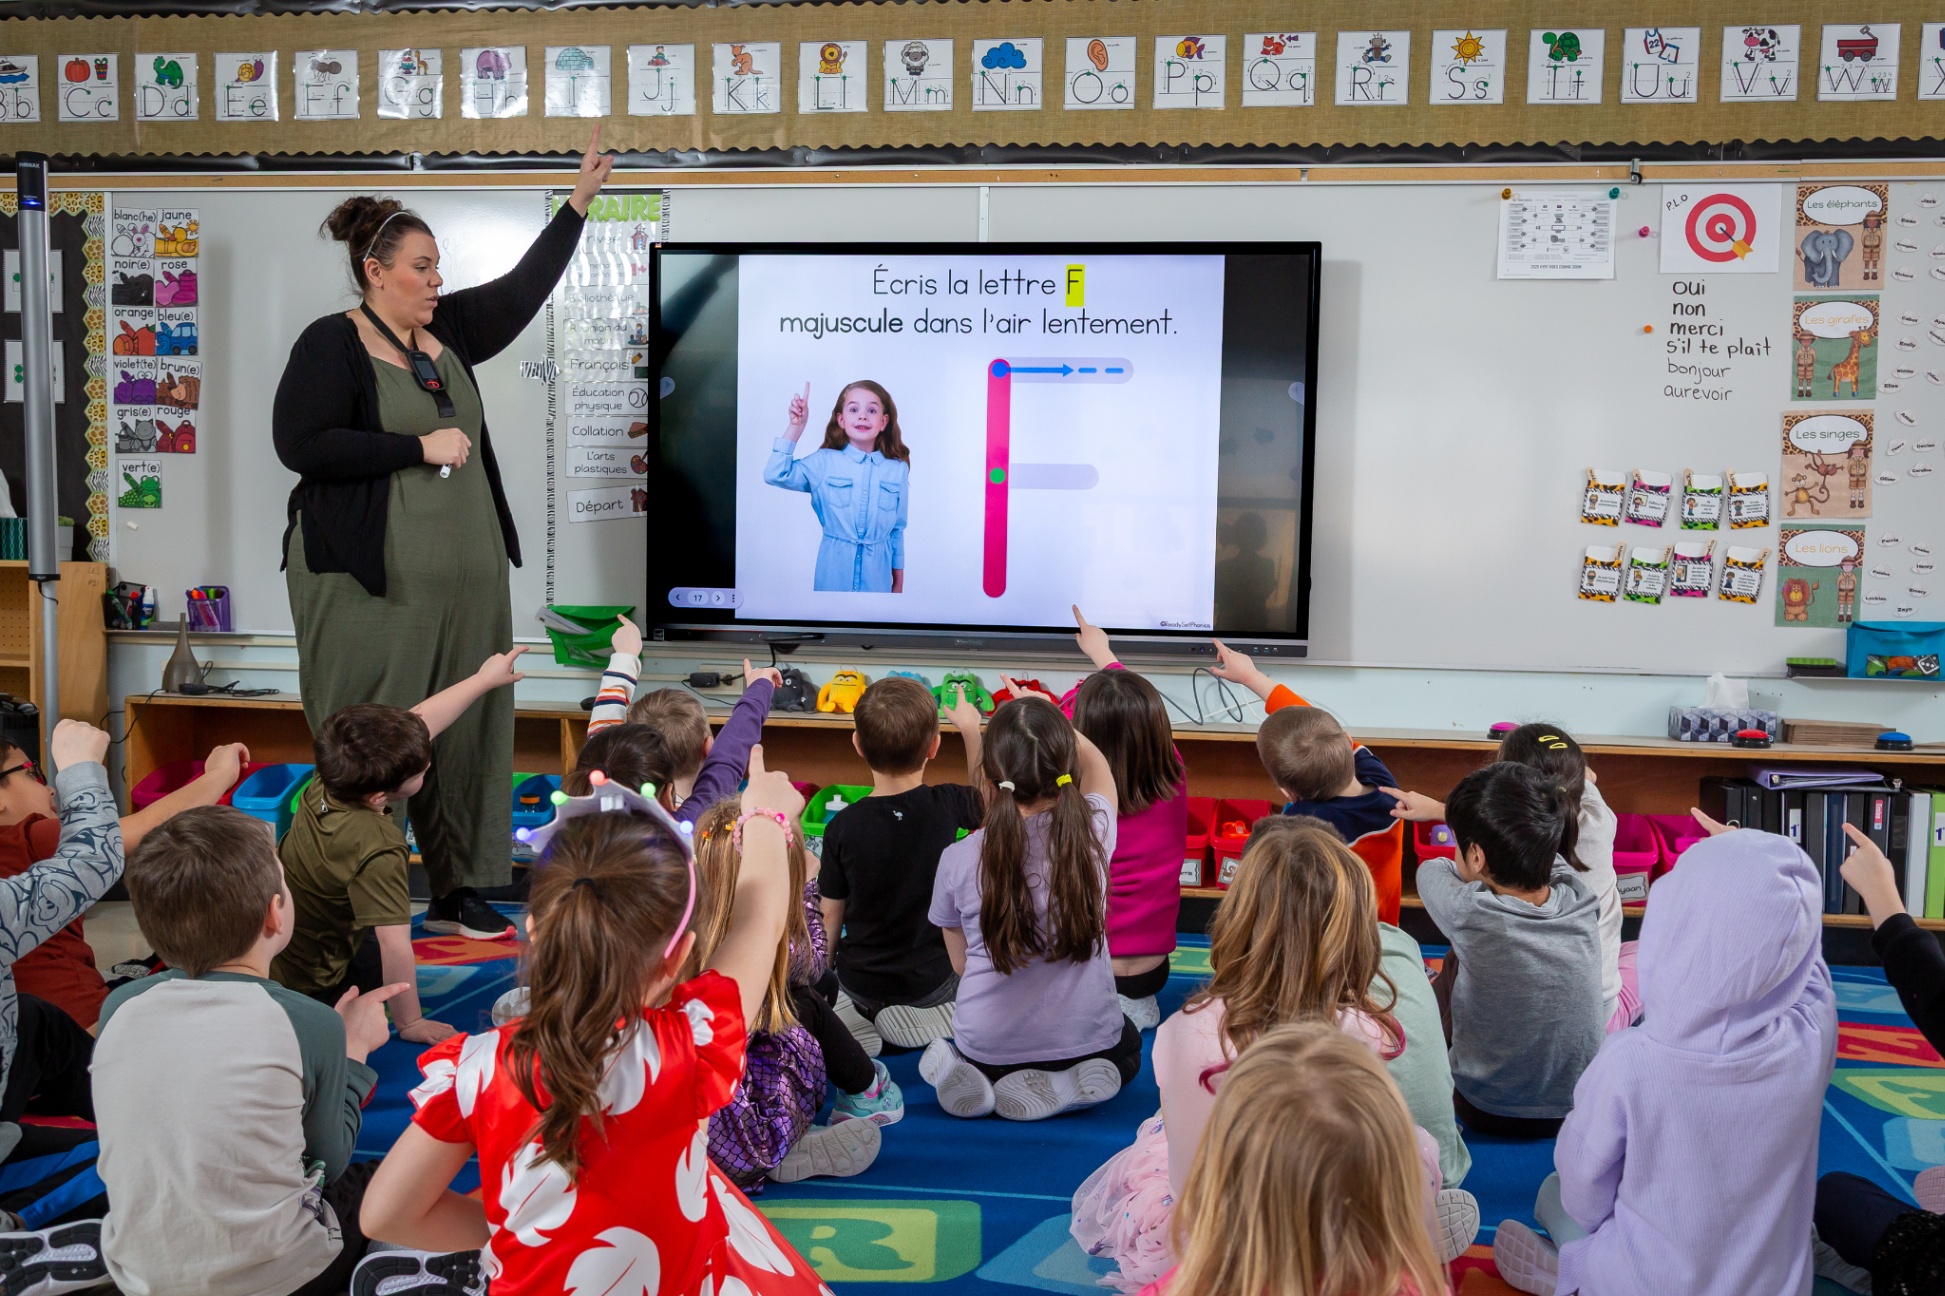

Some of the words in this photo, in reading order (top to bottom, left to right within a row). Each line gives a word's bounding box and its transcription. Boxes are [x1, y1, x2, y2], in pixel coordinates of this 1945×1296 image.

[1647, 38, 1661, 49] 22
[1807, 200, 1824, 209] Les
[1827, 200, 1878, 211] éléphants
[114, 209, 156, 222] blanc(he)
[160, 210, 192, 223] jaune
[114, 260, 150, 270] noir(e)
[161, 261, 188, 270] rose
[873, 263, 937, 295] Écris
[948, 269, 968, 295] la
[979, 269, 1056, 295] lettre
[1067, 268, 1083, 295] F
[114, 309, 154, 320] orange
[1673, 302, 1705, 317] non
[157, 310, 193, 322] bleu(e)
[1805, 315, 1825, 325] Les
[1827, 315, 1869, 327] girafes
[780, 307, 903, 339] majuscule
[914, 308, 972, 334] dans
[983, 308, 1031, 334] l'air
[1043, 308, 1177, 335] lentement.
[1670, 318, 1723, 336] merci
[1699, 339, 1719, 354] te
[1727, 336, 1771, 359] plaît
[114, 358, 156, 370] violet(te)
[160, 358, 200, 375] brun(e)
[1668, 357, 1731, 385] bonjour
[572, 385, 625, 397] Éducation
[157, 407, 191, 419] rouge
[574, 401, 623, 413] physique
[117, 407, 151, 420] gris(e)
[572, 426, 624, 437] Collation
[1796, 429, 1816, 439] Les
[1819, 429, 1860, 441] singes
[587, 451, 615, 461] L'arts
[122, 461, 160, 473] vert(e)
[574, 463, 627, 475] plastiques
[576, 500, 623, 515] Départ
[1795, 543, 1816, 553] Les
[1819, 543, 1848, 554] lions
[694, 594, 703, 602] 17
